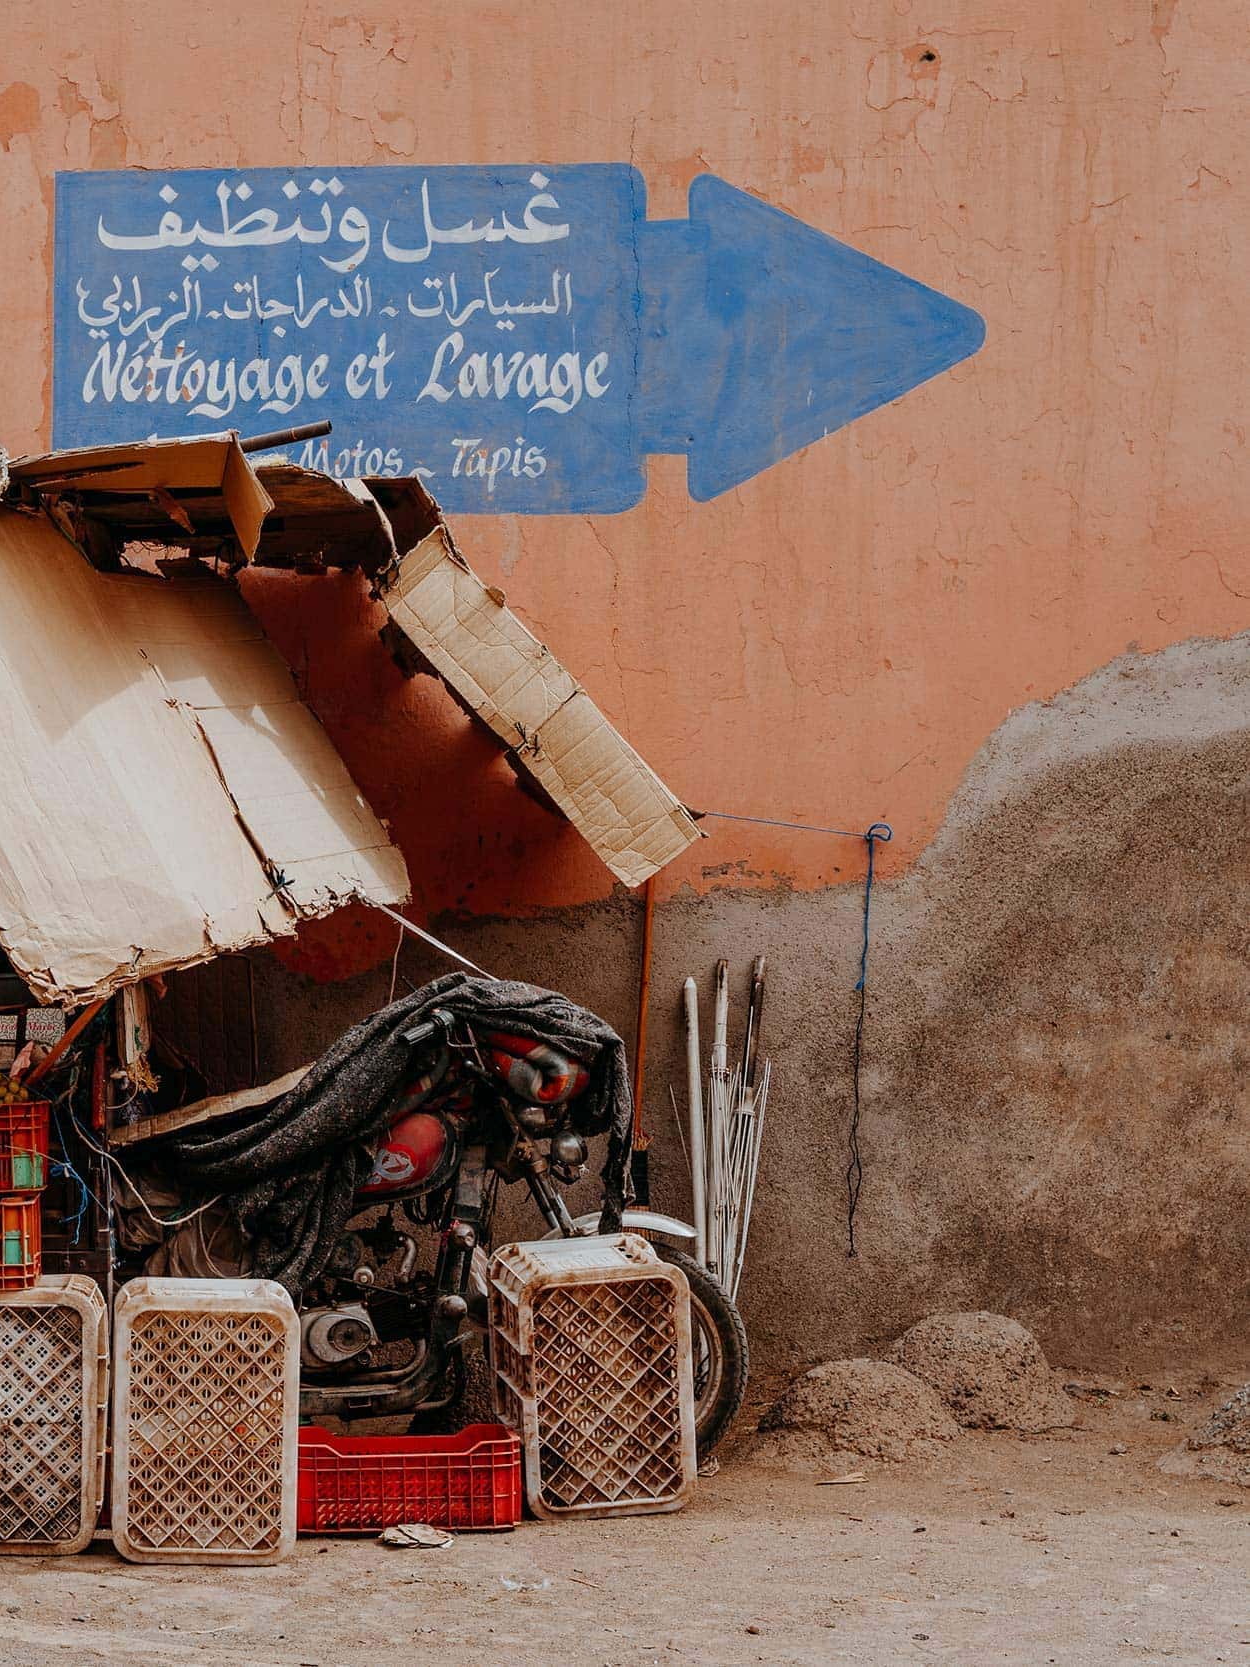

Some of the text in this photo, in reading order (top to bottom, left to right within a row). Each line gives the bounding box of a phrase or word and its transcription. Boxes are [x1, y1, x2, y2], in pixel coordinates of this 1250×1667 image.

[97, 171, 570, 272] غسل وتنظيف
[76, 267, 573, 343] السيارات الدراجات الزرابي
[346, 332, 395, 400] et
[416, 332, 613, 414] Lavage
[299, 436, 549, 494] Motos Tapis
